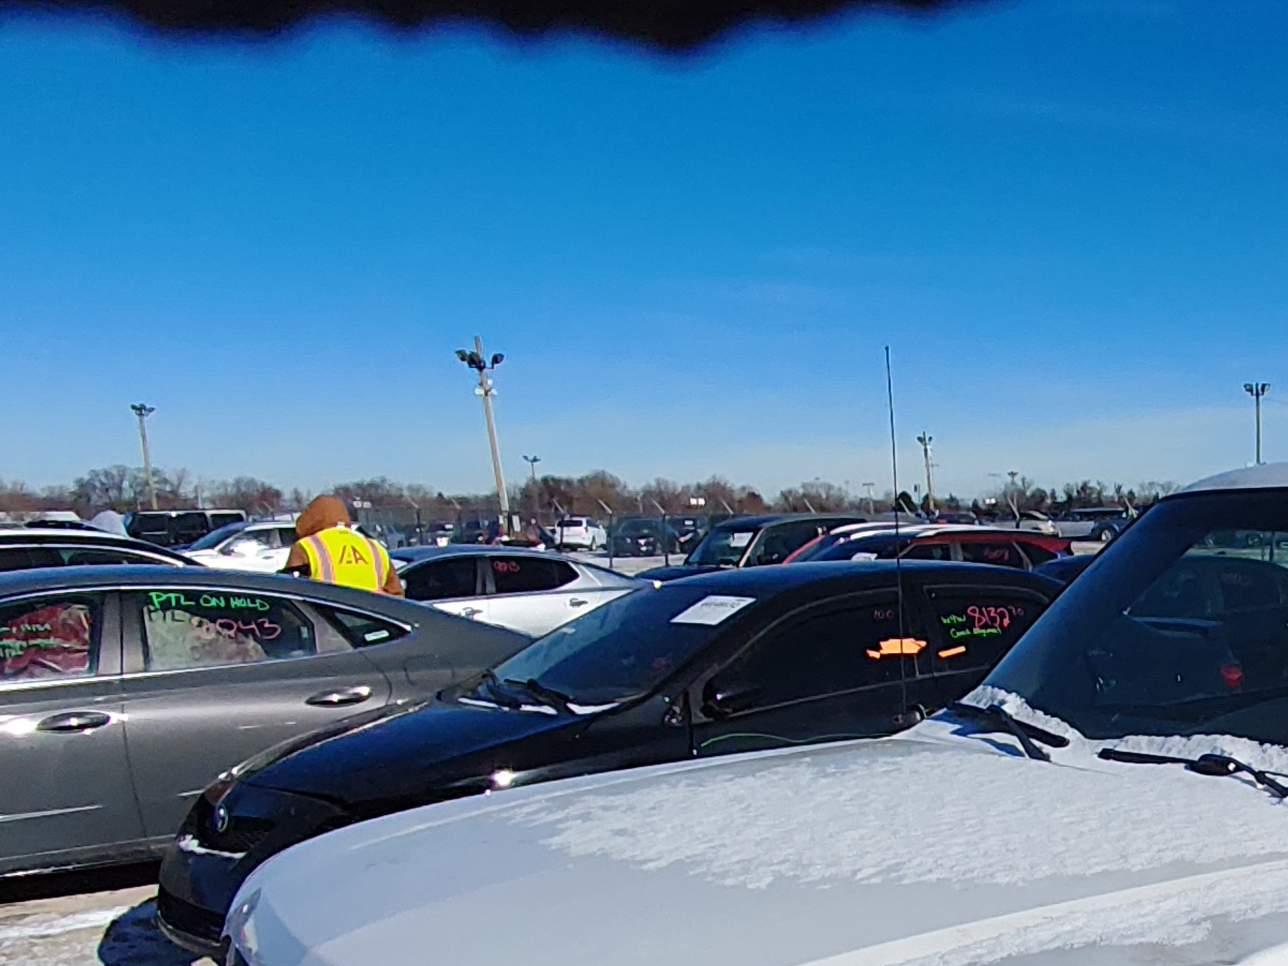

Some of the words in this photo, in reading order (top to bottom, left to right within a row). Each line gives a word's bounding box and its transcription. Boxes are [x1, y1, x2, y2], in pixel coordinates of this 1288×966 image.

[148, 591, 196, 609] PTL
[199, 593, 227, 608] ON
[230, 596, 271, 612] HOLD
